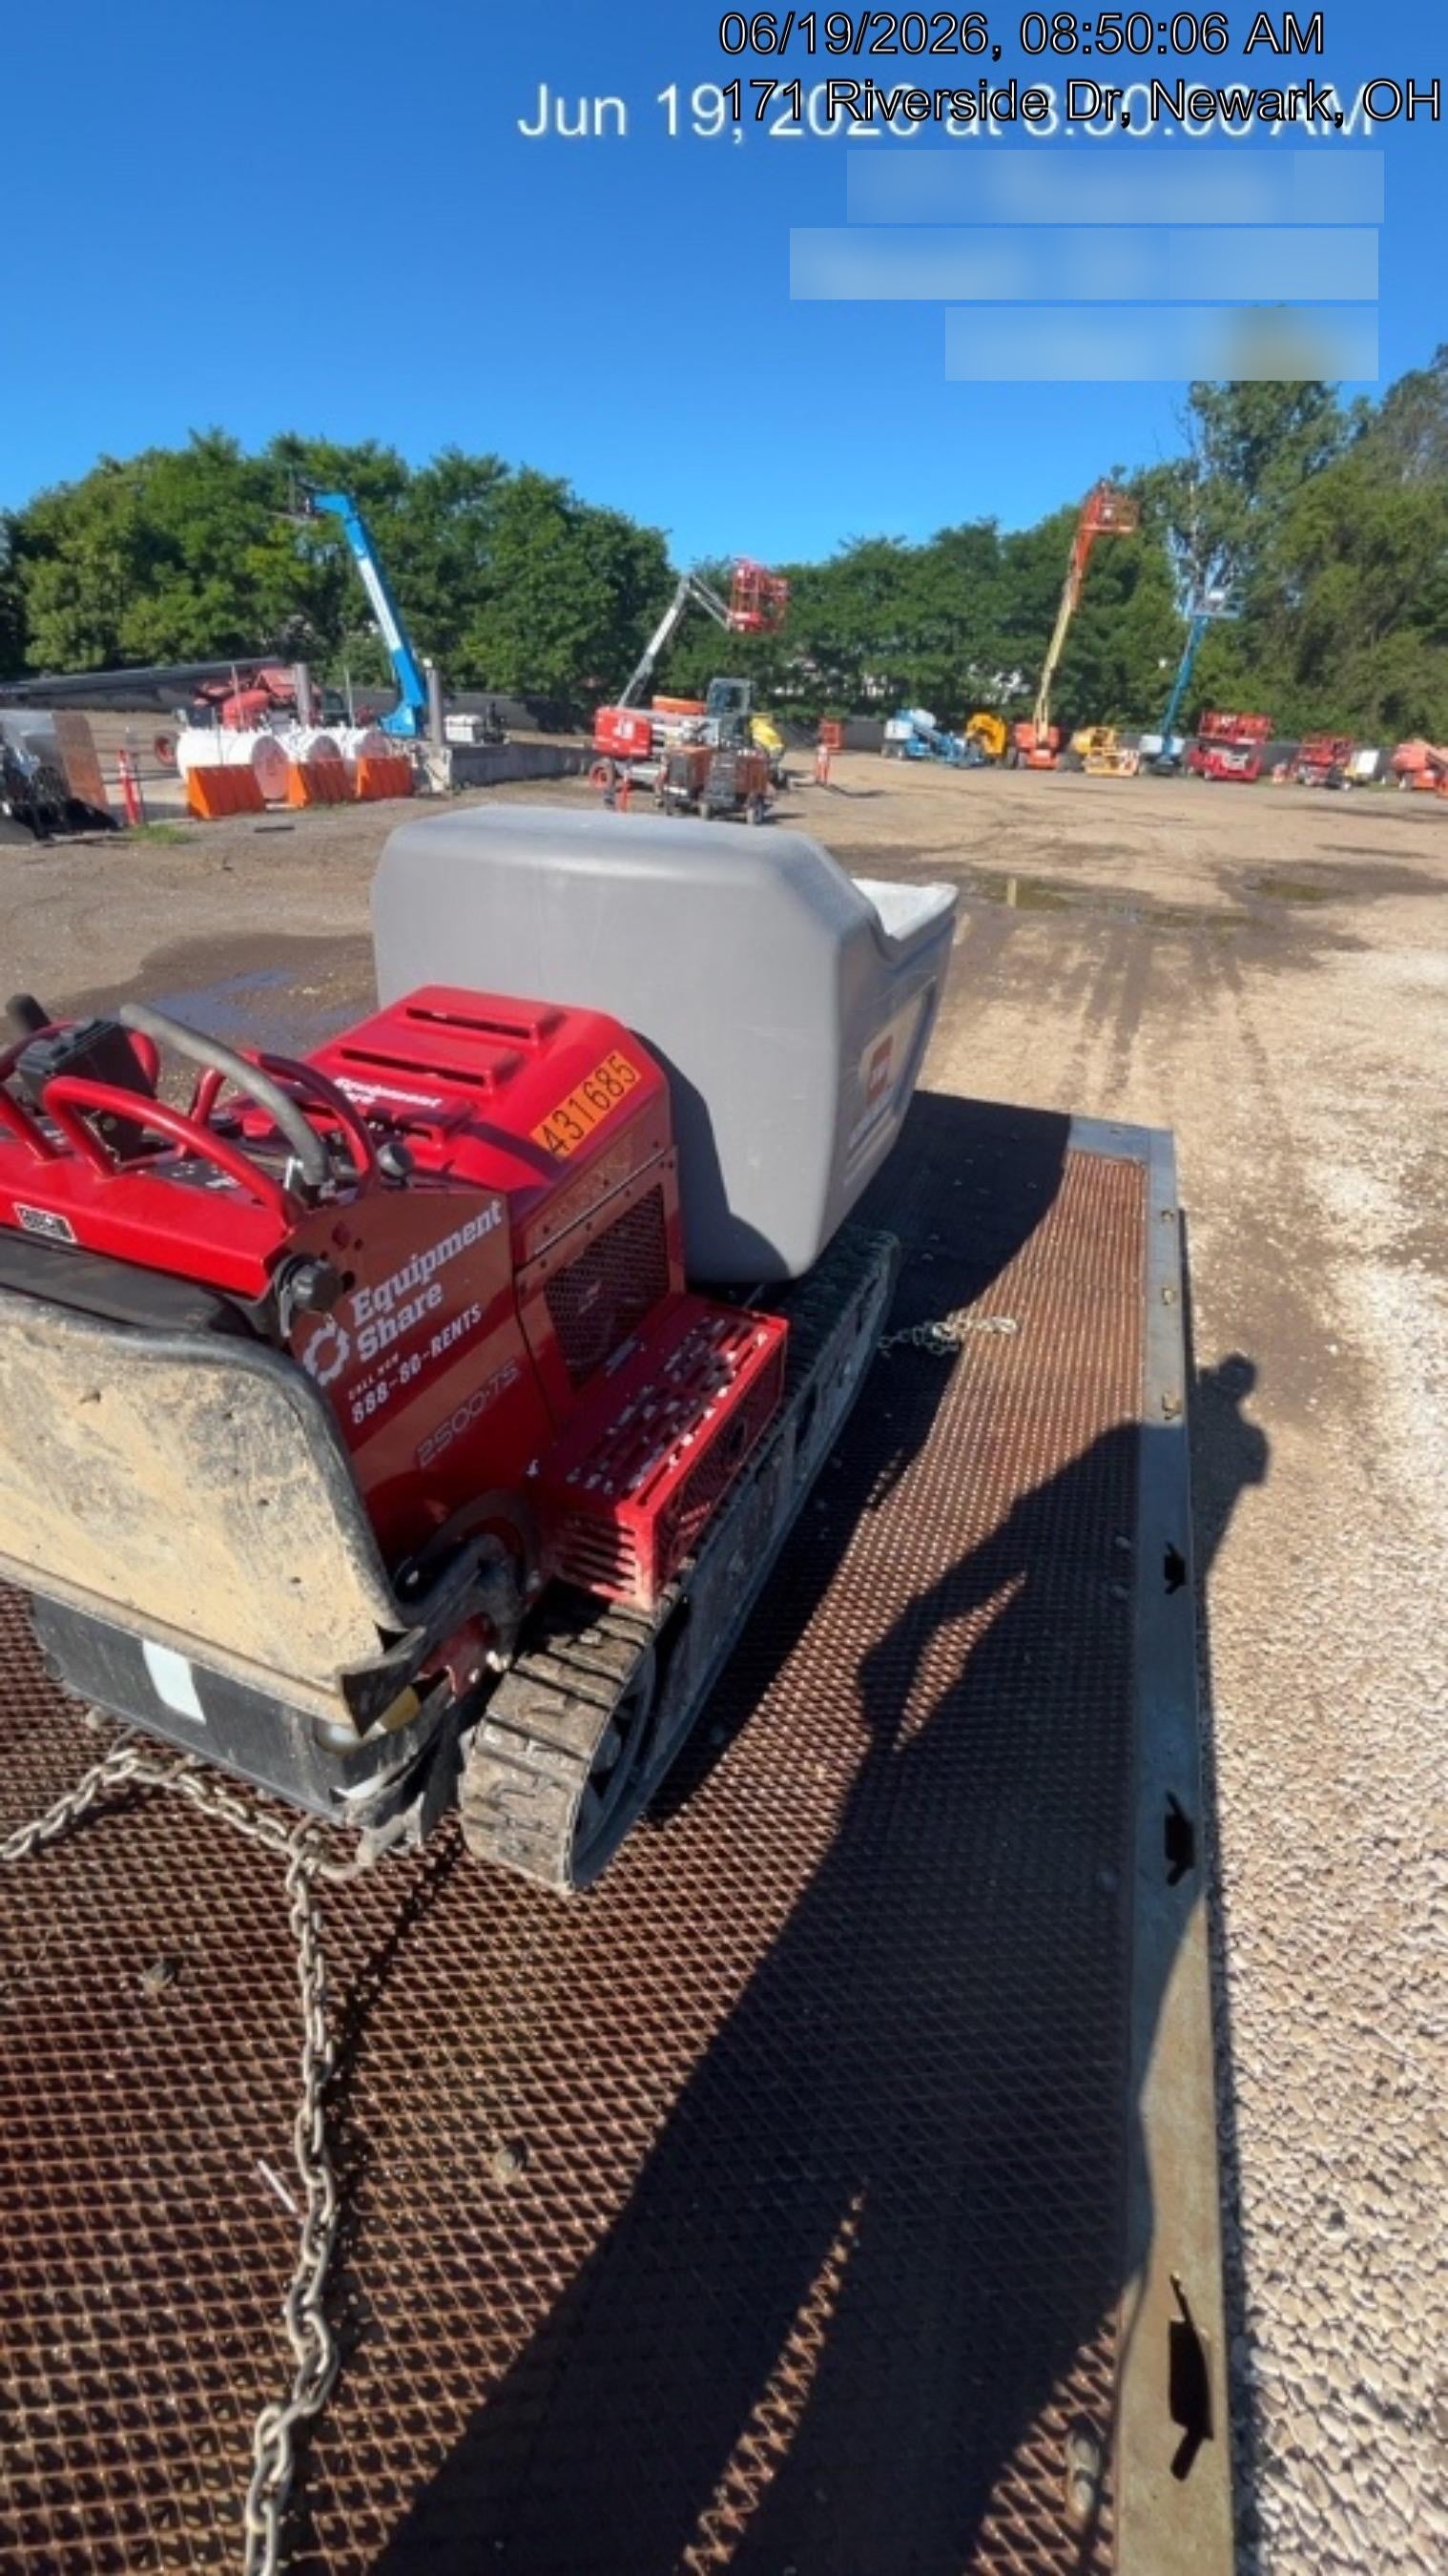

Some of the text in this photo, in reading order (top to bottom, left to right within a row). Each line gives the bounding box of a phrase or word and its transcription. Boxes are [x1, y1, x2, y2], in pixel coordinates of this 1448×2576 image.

[541, 1054, 637, 1154] 431685
[349, 1198, 503, 1328] Equipment
[357, 1282, 444, 1363] Share
